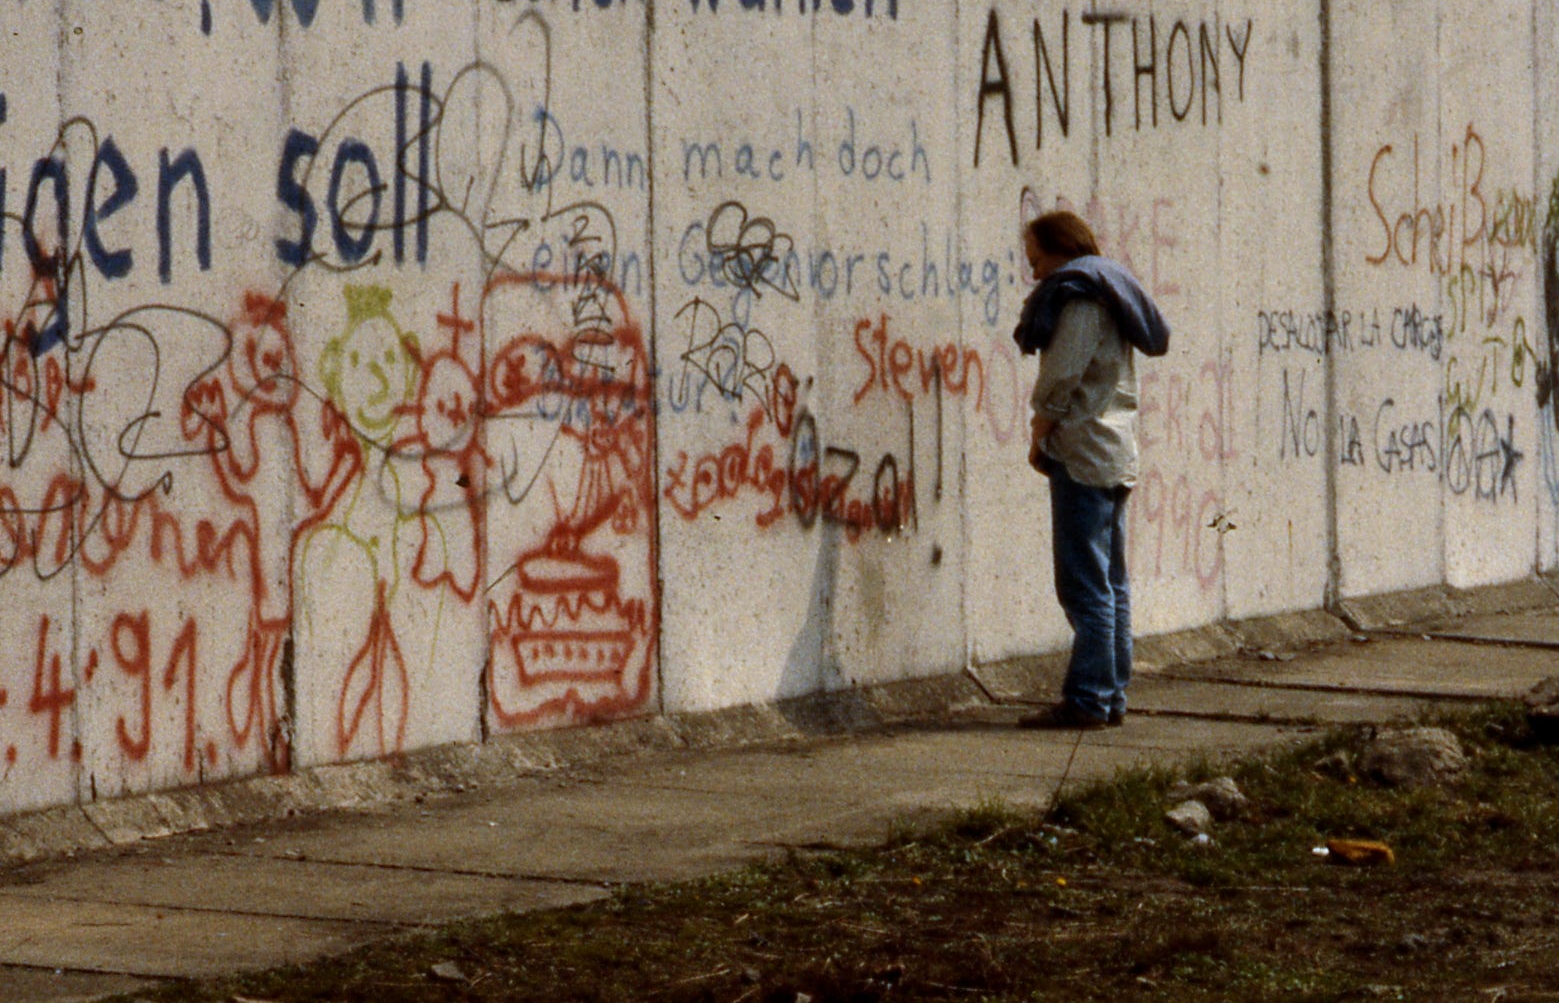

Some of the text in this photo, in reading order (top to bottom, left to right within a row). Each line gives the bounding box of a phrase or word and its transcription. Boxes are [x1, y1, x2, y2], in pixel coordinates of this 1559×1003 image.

[972, 5, 1251, 168] ANTHONY
[274, 60, 434, 268] soll
[533, 103, 932, 192] Dann mach doch
[852, 312, 986, 412] Steven
[1361, 306, 1383, 349] LA
